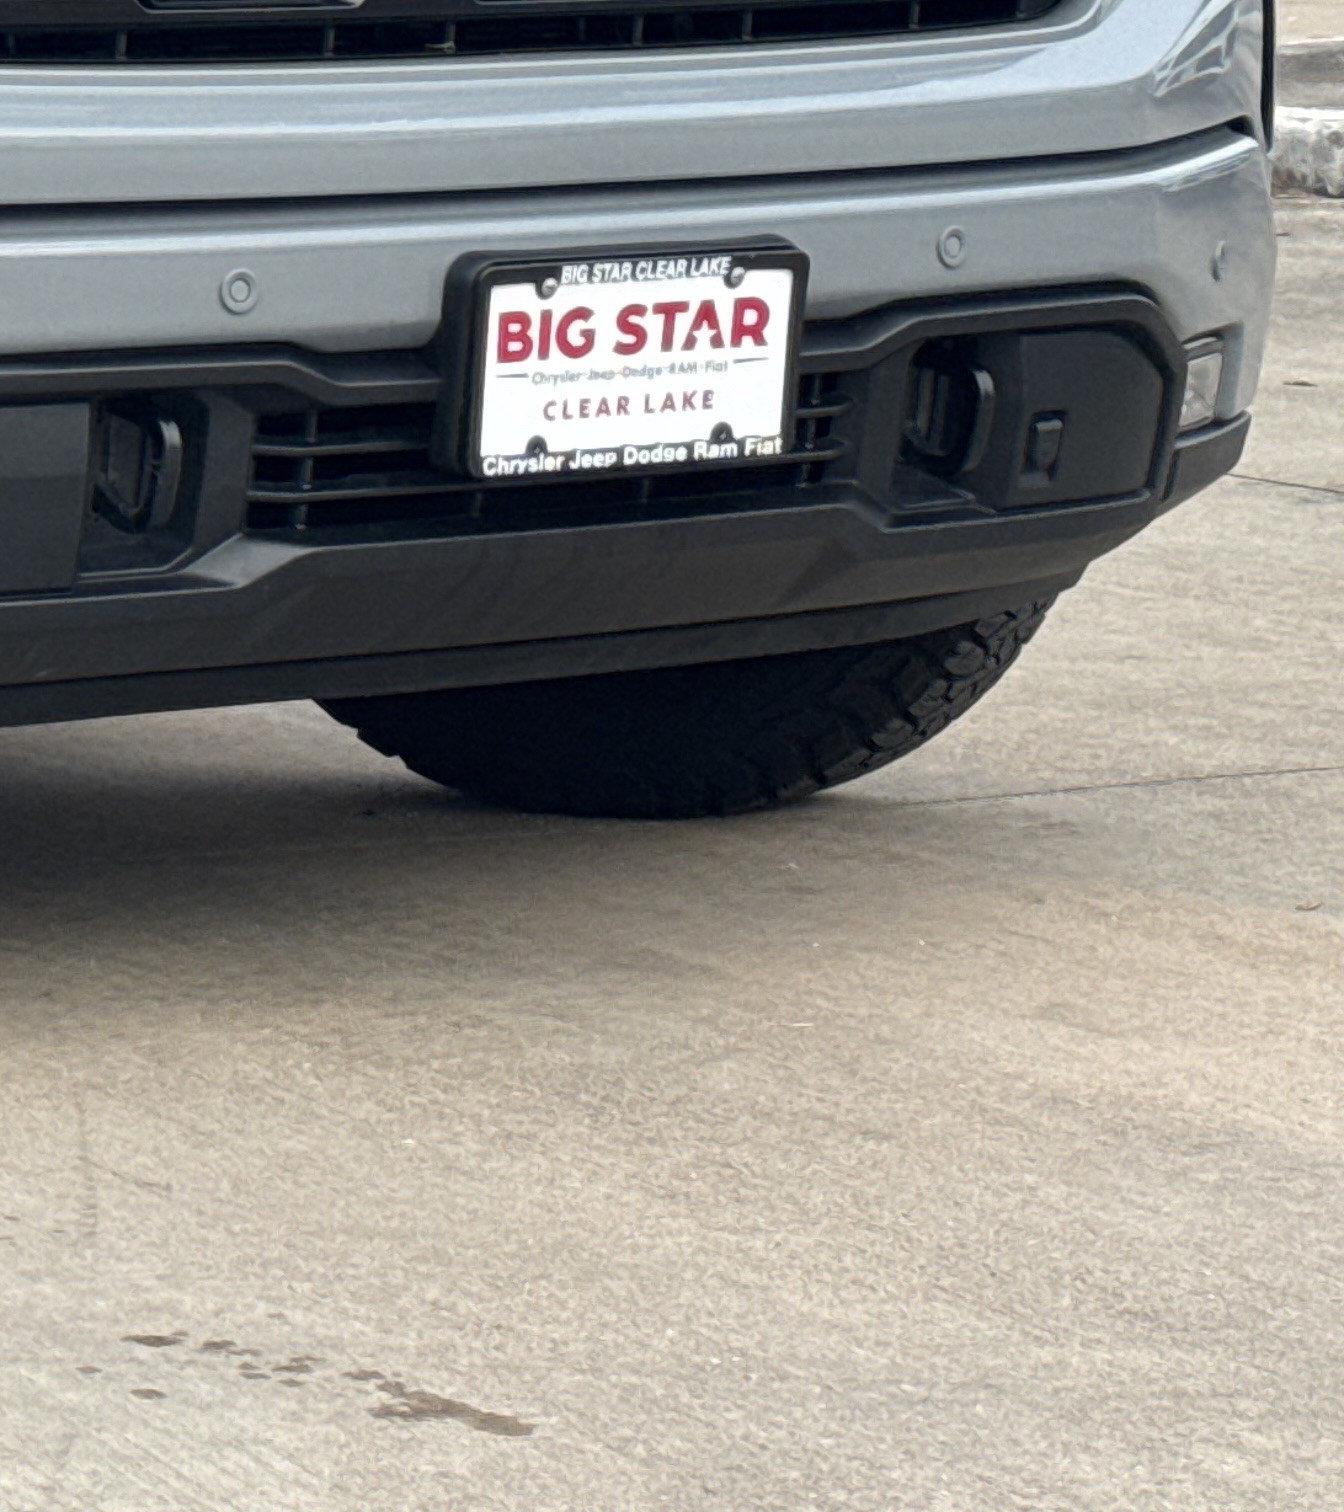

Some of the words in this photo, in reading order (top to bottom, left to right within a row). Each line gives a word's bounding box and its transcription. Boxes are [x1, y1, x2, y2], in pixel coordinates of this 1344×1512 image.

[561, 263, 589, 284] BIG
[592, 261, 633, 283] STAR
[635, 258, 688, 280] CLEAR
[689, 255, 733, 276] LAKE
[497, 306, 596, 364] BIG
[613, 296, 770, 356] STAR
[543, 395, 630, 421] CLEAR
[643, 389, 715, 414] LAKE
[482, 451, 566, 477] Chrysler
[568, 448, 618, 470] Jeep
[623, 443, 688, 466] Dodge
[693, 440, 738, 461] Ram
[744, 437, 784, 457] Fiat
